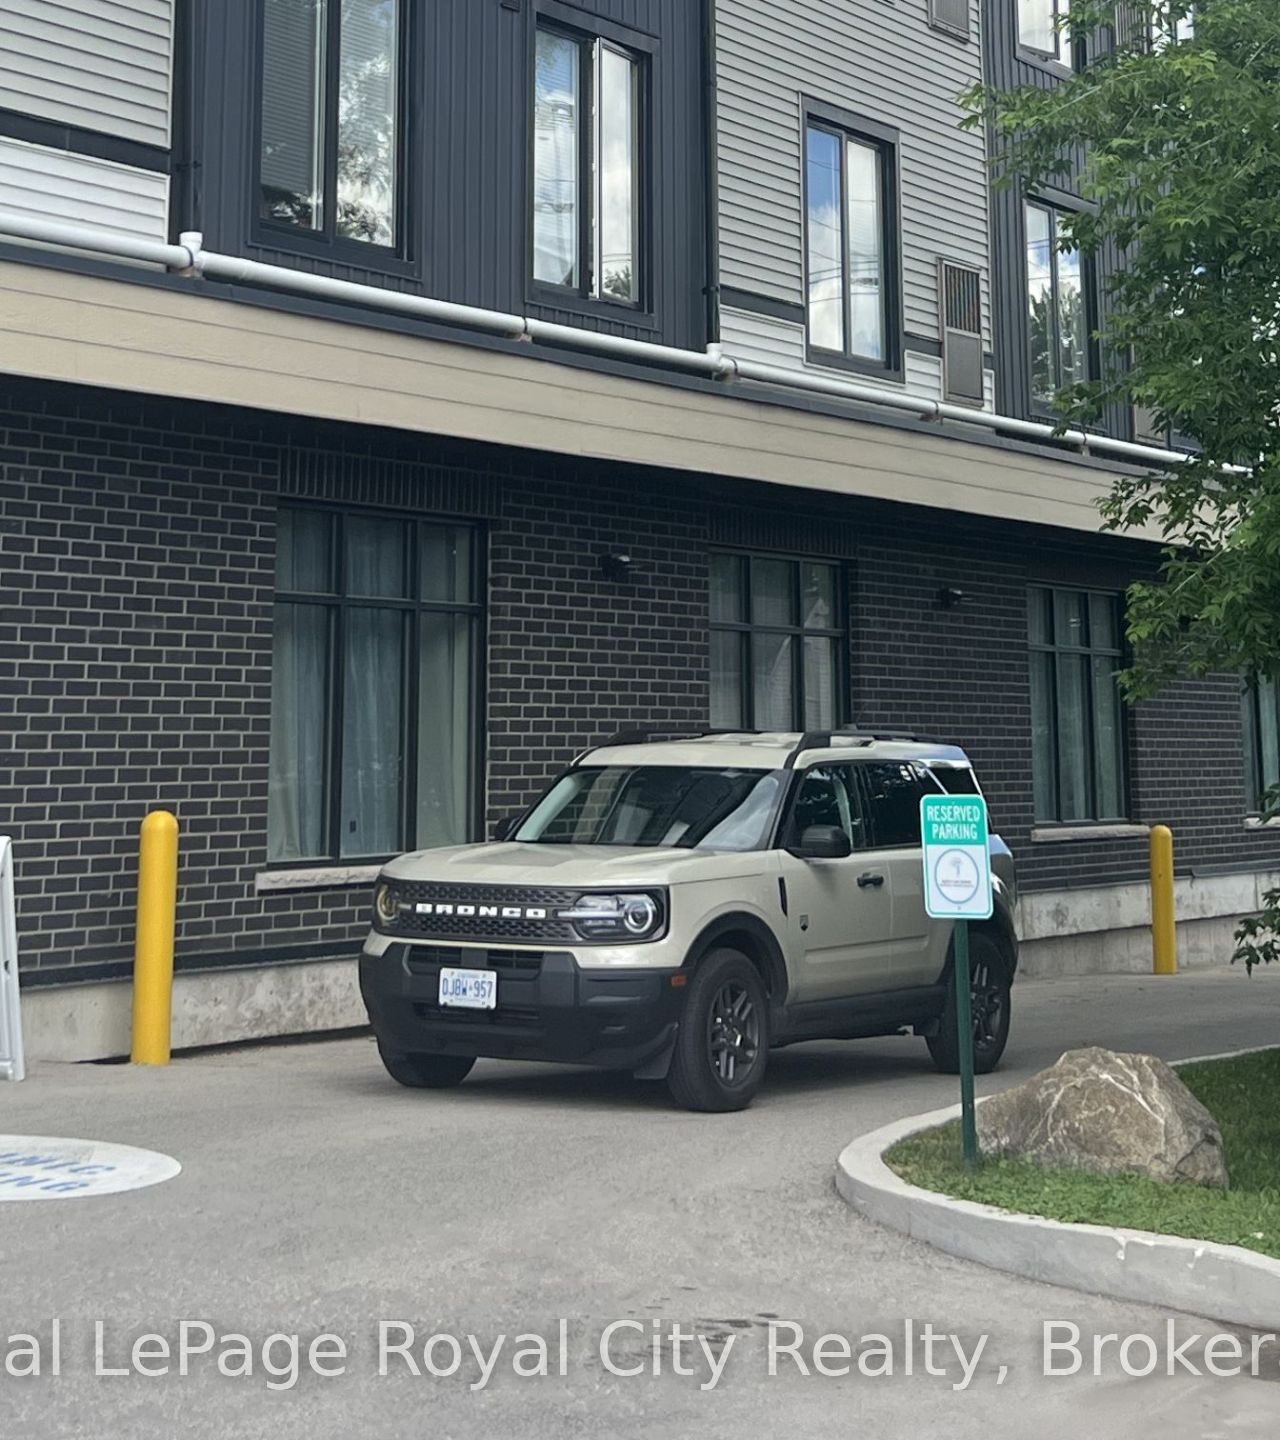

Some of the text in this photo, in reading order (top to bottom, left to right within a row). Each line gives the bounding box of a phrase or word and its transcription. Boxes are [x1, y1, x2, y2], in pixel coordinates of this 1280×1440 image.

[927, 805, 981, 822] RESERVED
[932, 823, 978, 840] PARKING
[416, 903, 546, 919] BRONCO
